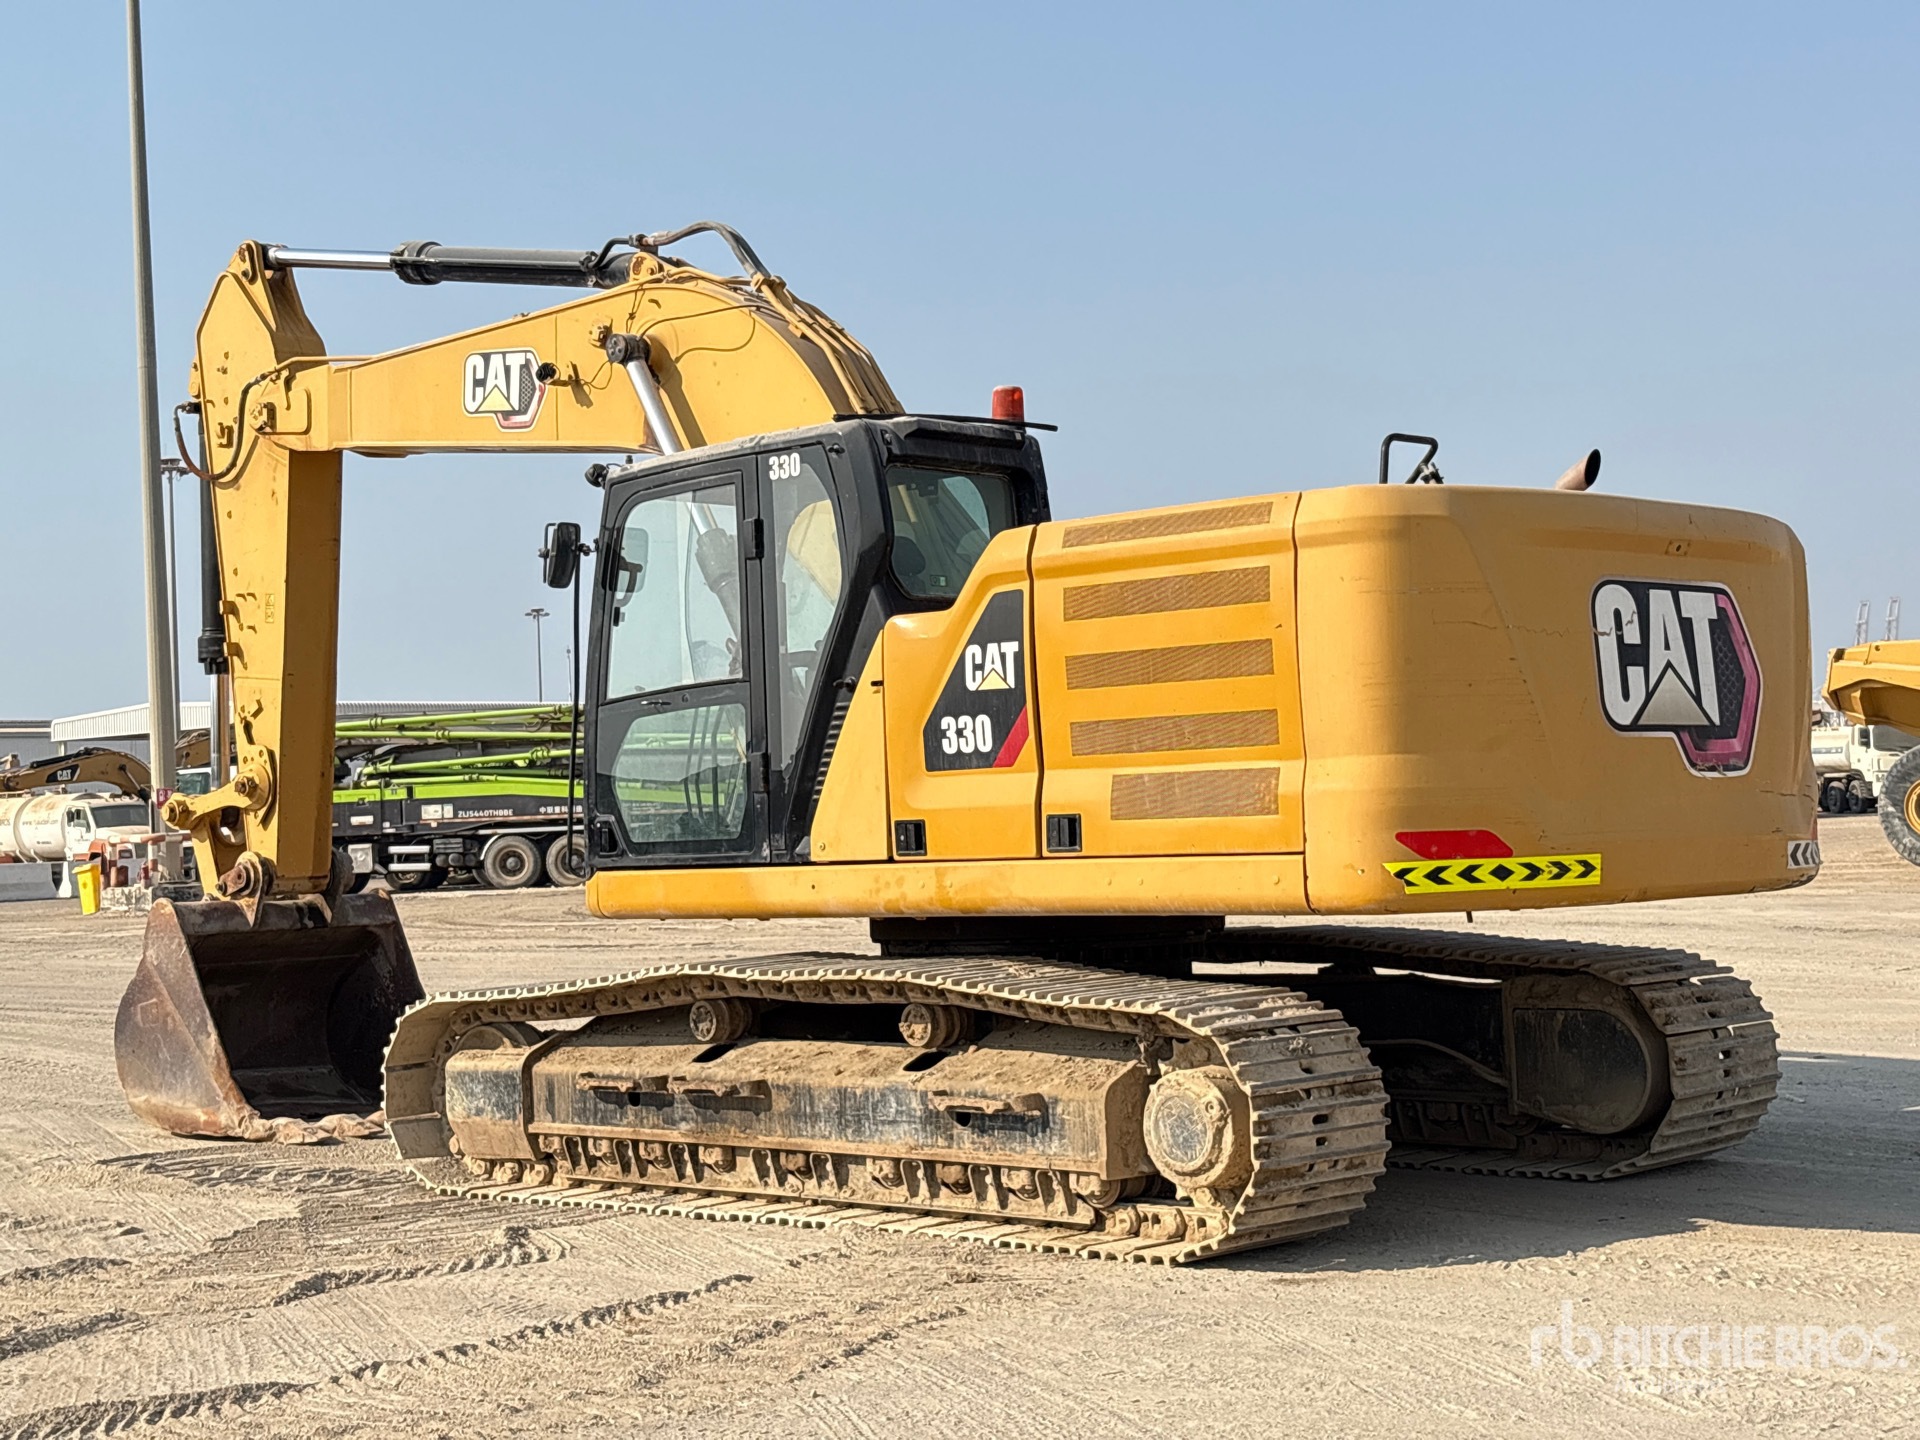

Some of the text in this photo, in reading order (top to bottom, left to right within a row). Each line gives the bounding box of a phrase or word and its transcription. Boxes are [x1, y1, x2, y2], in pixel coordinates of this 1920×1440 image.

[465, 351, 526, 413] CAT
[768, 452, 802, 481] 330
[964, 641, 1019, 692] CAT
[1594, 583, 1720, 726] CAT
[940, 713, 993, 755] 330
[57, 769, 72, 781] CAT
